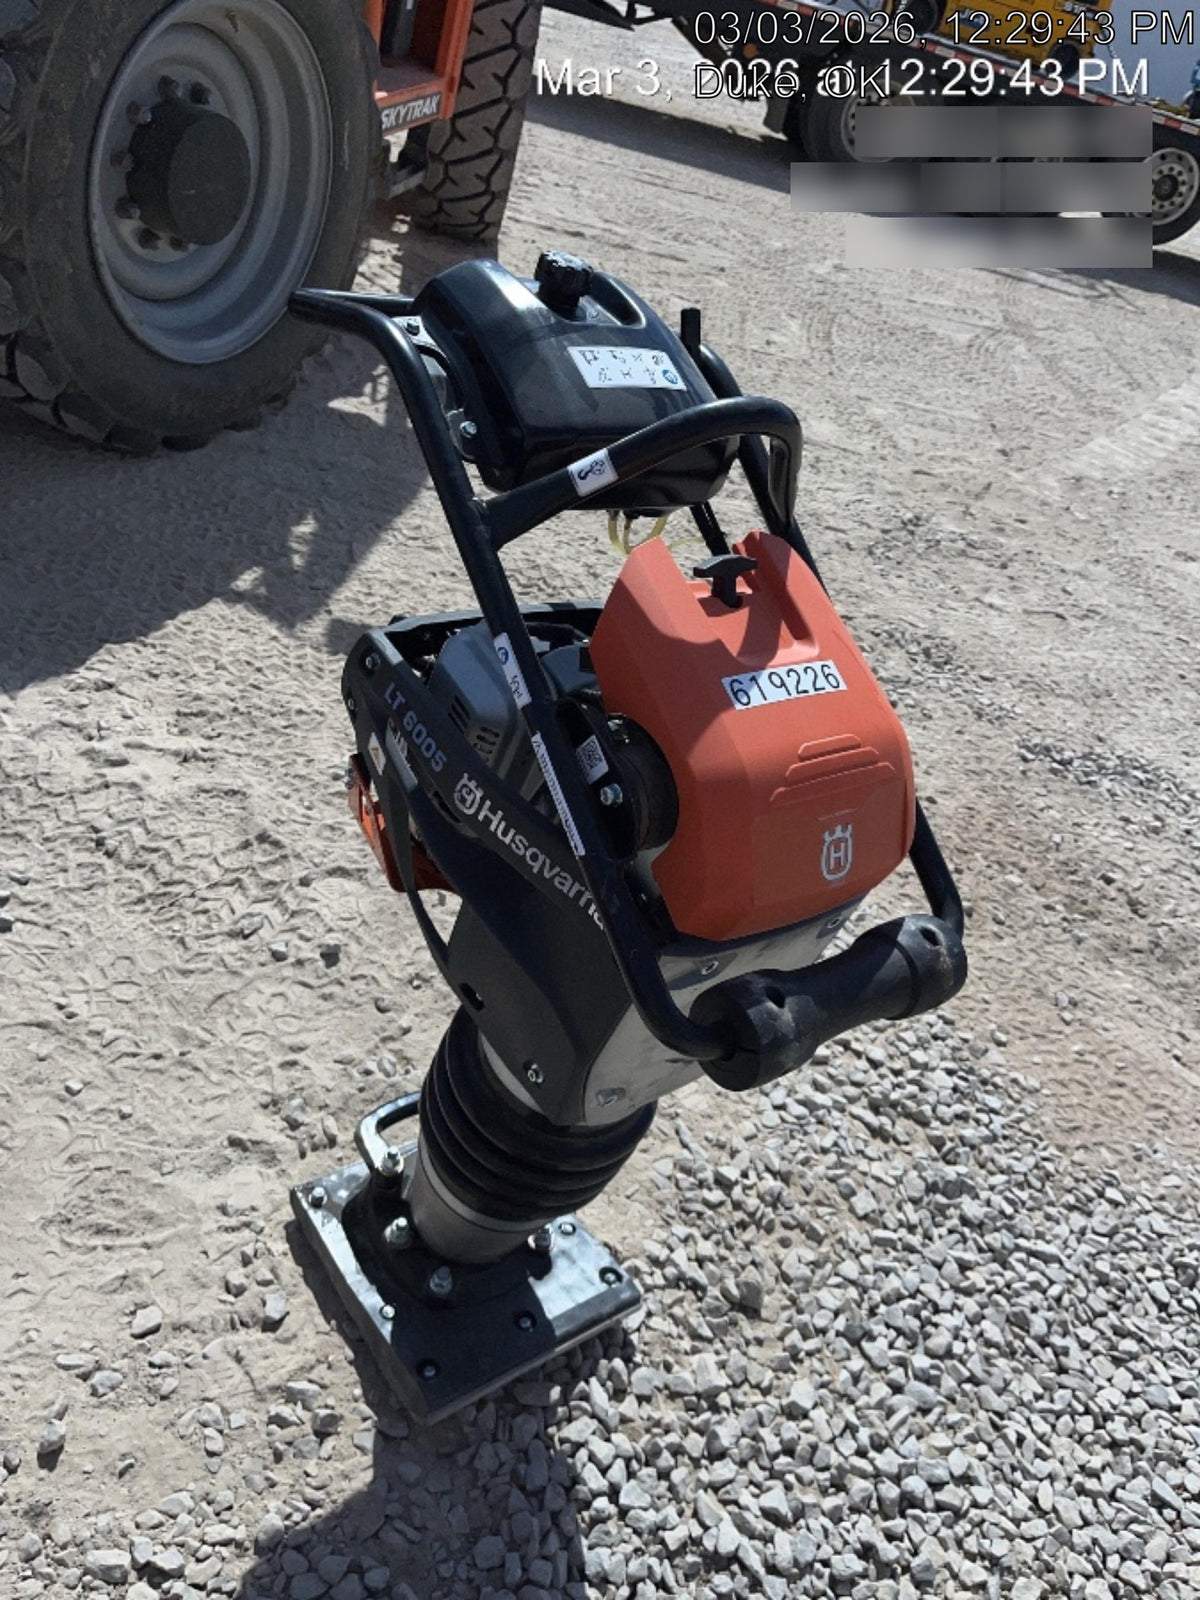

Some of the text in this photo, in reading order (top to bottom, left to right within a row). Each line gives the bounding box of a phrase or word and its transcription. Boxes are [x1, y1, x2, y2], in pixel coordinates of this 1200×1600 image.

[381, 94, 440, 130] SKYTRAK
[730, 664, 841, 707] 619226
[384, 682, 406, 711] LT
[403, 710, 448, 773] 6005
